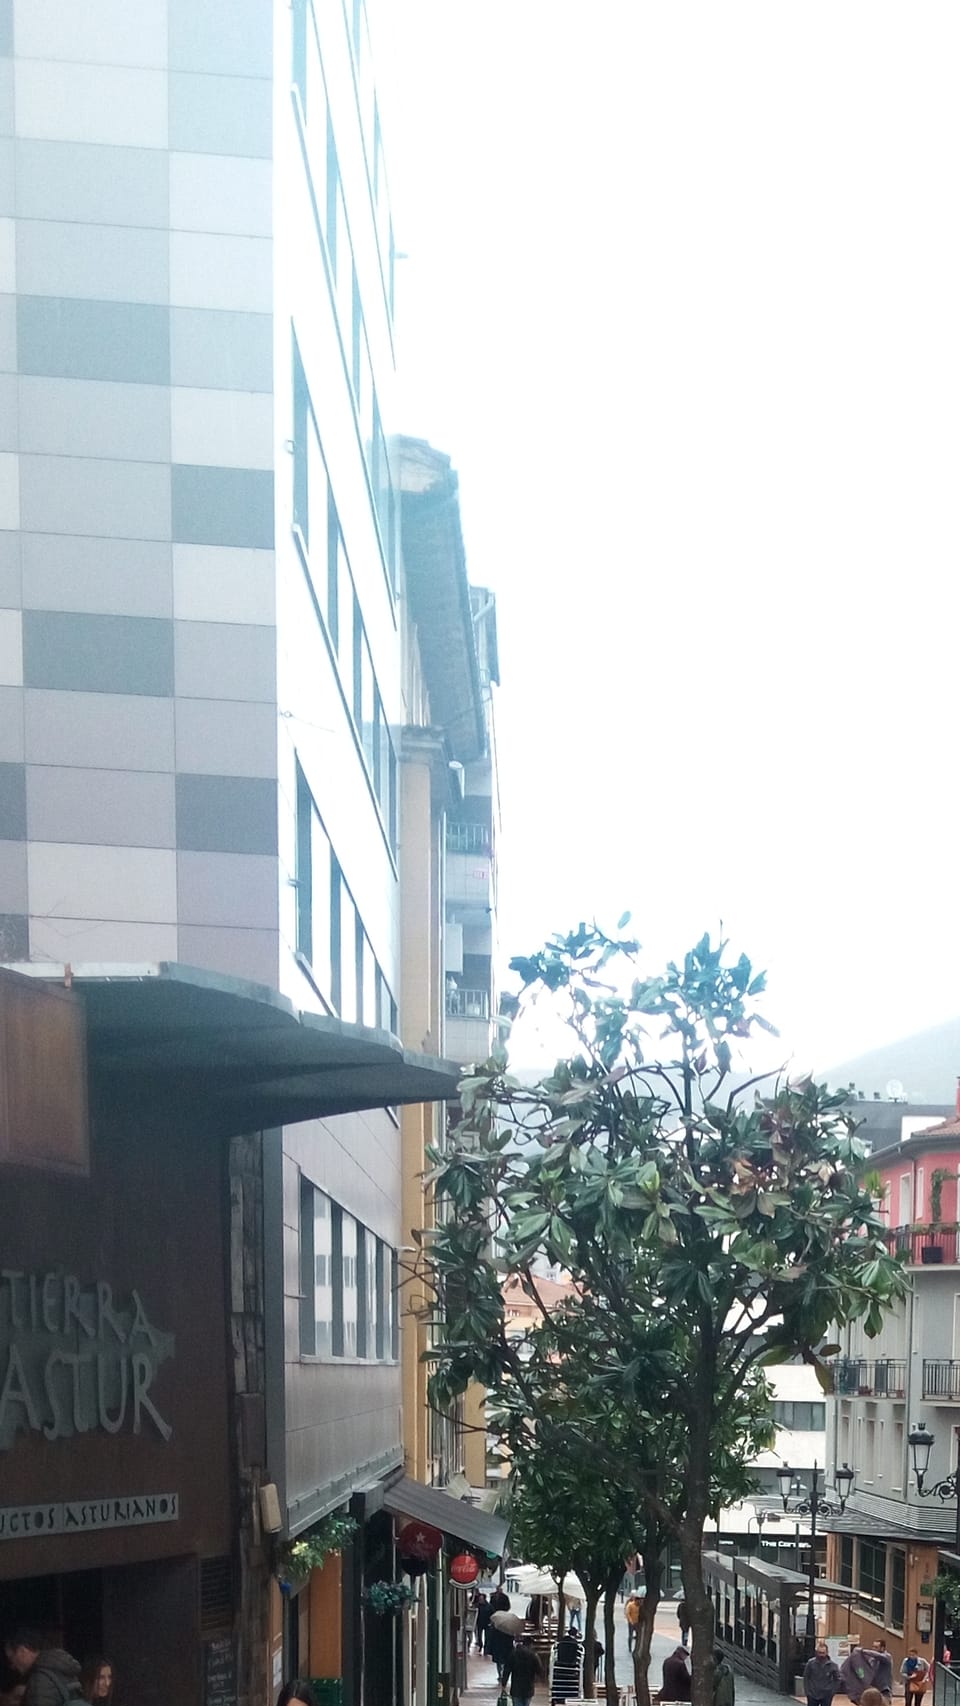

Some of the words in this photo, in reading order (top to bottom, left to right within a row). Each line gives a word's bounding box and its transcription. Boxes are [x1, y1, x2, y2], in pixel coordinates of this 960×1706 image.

[1, 1269, 160, 1347] TIERRA
[0, 1342, 173, 1441] ASTUR
[65, 1495, 176, 1527] ASTURIANOS
